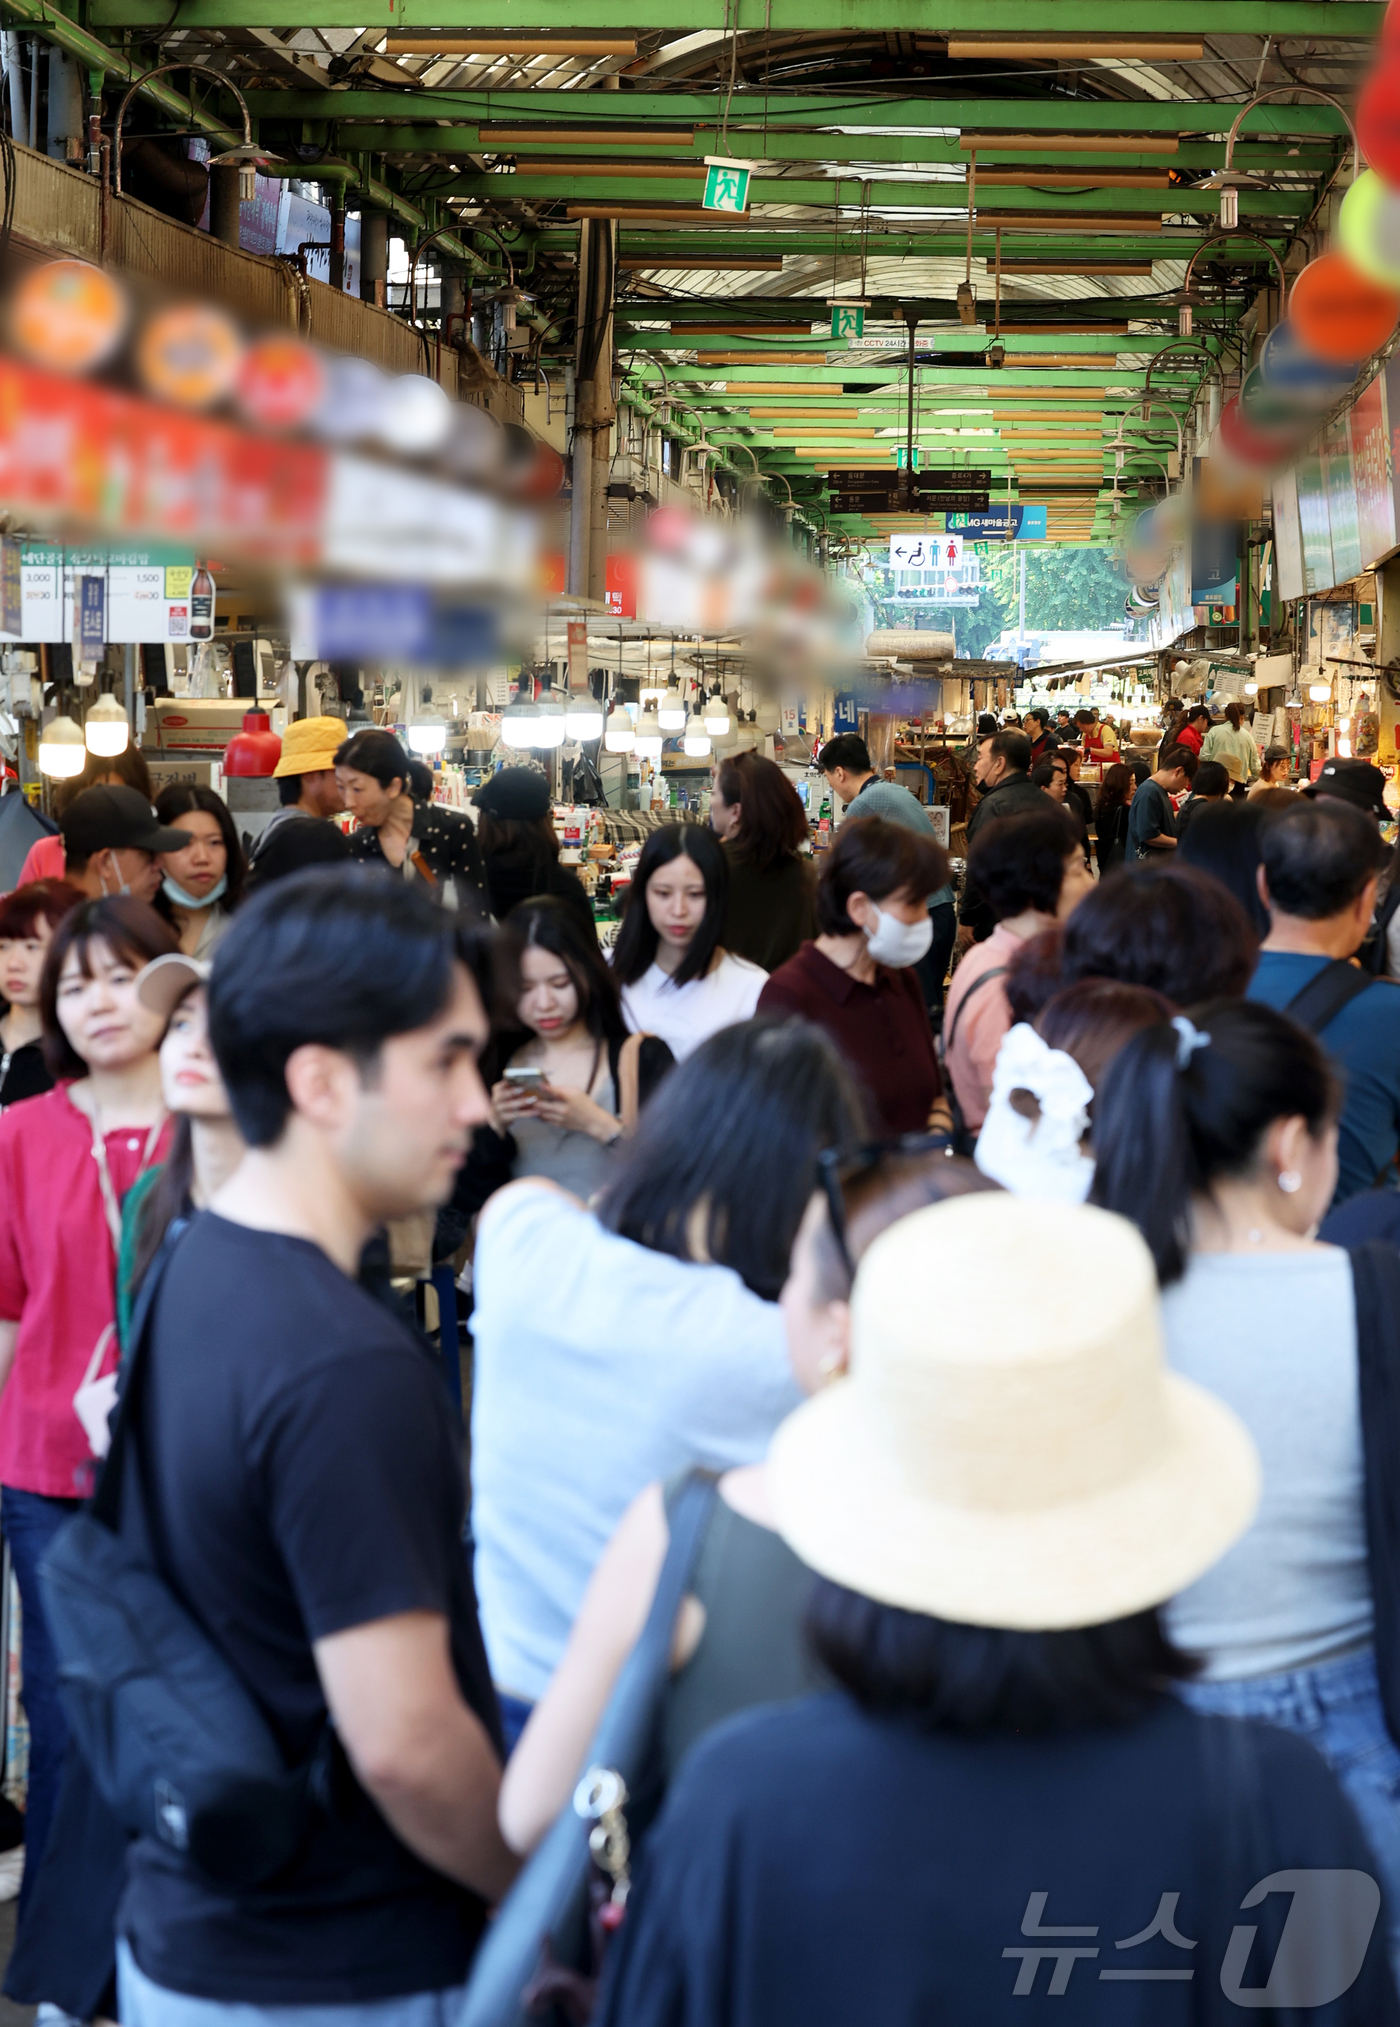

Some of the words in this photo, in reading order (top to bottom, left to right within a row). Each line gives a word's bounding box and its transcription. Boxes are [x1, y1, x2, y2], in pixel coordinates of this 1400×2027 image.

[26, 573, 51, 582] 3,000
[137, 574, 160, 582] 1,500
[784, 709, 796, 720] 15
